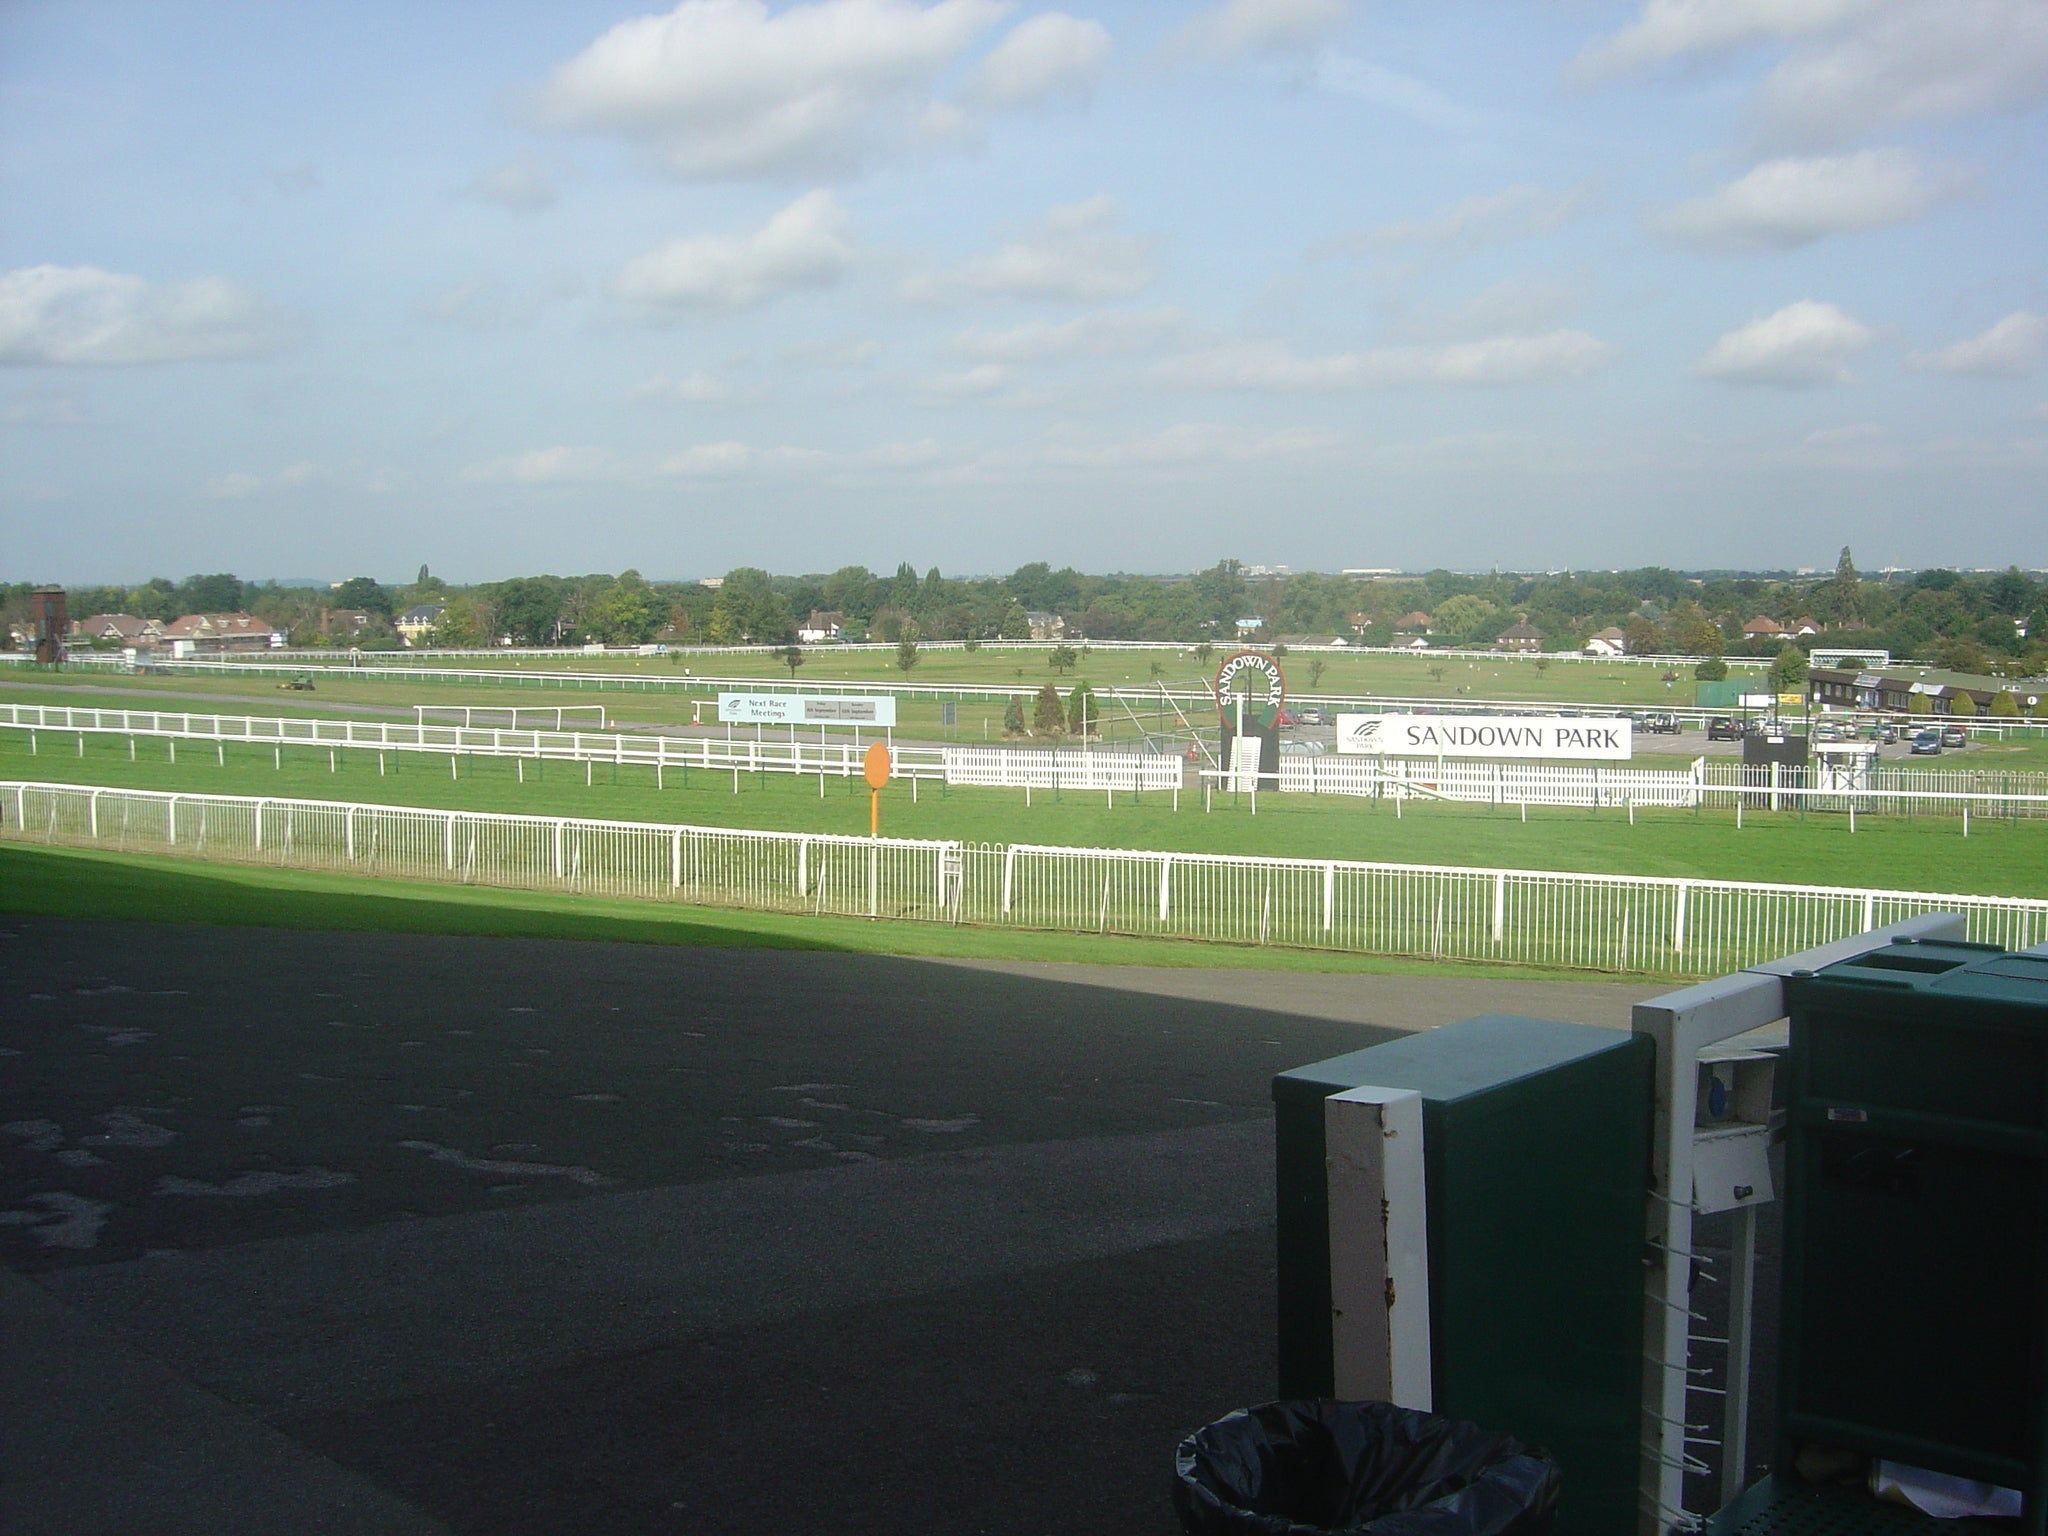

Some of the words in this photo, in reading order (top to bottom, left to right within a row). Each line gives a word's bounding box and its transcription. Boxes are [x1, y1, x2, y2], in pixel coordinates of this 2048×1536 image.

[1218, 655, 1269, 706] SANDOWN
[1265, 664, 1282, 708] PARK
[749, 699, 766, 707] Next
[769, 699, 787, 707] Race
[751, 709, 785, 719] Meetings
[1407, 725, 1542, 748] SANDOWN
[1555, 728, 1620, 749] PARK
